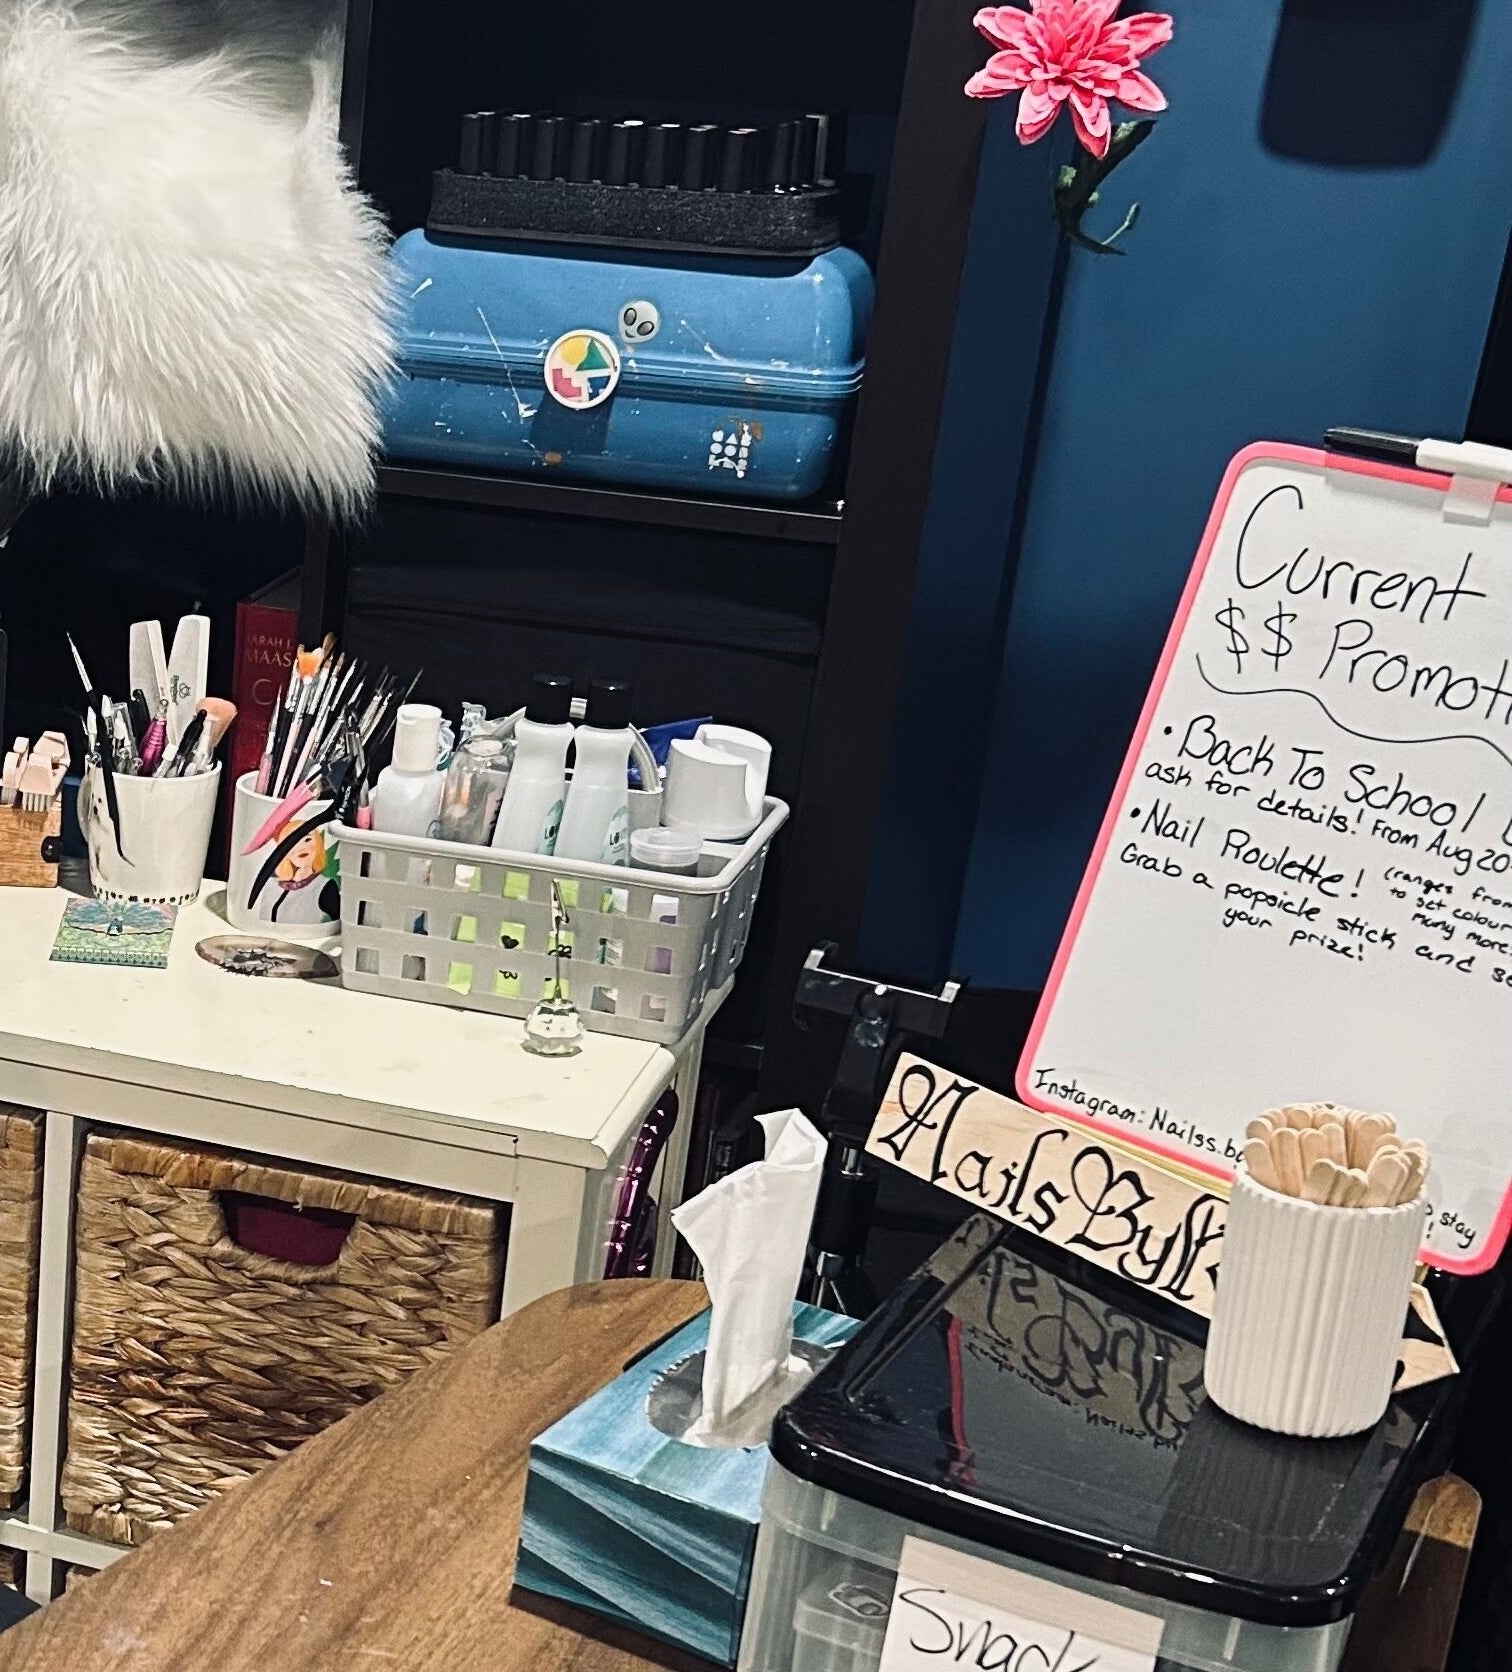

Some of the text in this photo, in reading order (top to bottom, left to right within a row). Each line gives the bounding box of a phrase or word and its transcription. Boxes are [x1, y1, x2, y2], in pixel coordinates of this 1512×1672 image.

[1236, 485, 1487, 623] Current
[247, 648, 293, 668] MAAS
[1176, 714, 1487, 833] Back To School
[1145, 761, 1192, 788] ask
[1204, 769, 1251, 797] for
[1256, 788, 1365, 836] details!
[1424, 828, 1473, 877] Aug
[1140, 798, 1365, 899] Nail Roulette!
[1119, 842, 1183, 878] Grab
[1192, 871, 1215, 891] a
[1223, 882, 1322, 923] popsicle
[1336, 916, 1398, 950] stick
[1414, 944, 1476, 974] and
[1390, 886, 1407, 900] to
[1415, 896, 1448, 911] set
[1410, 911, 1456, 942] many
[1221, 906, 1364, 962] your prize!
[1034, 1067, 1146, 1124] Instagram:
[1439, 1211, 1477, 1250] stay
